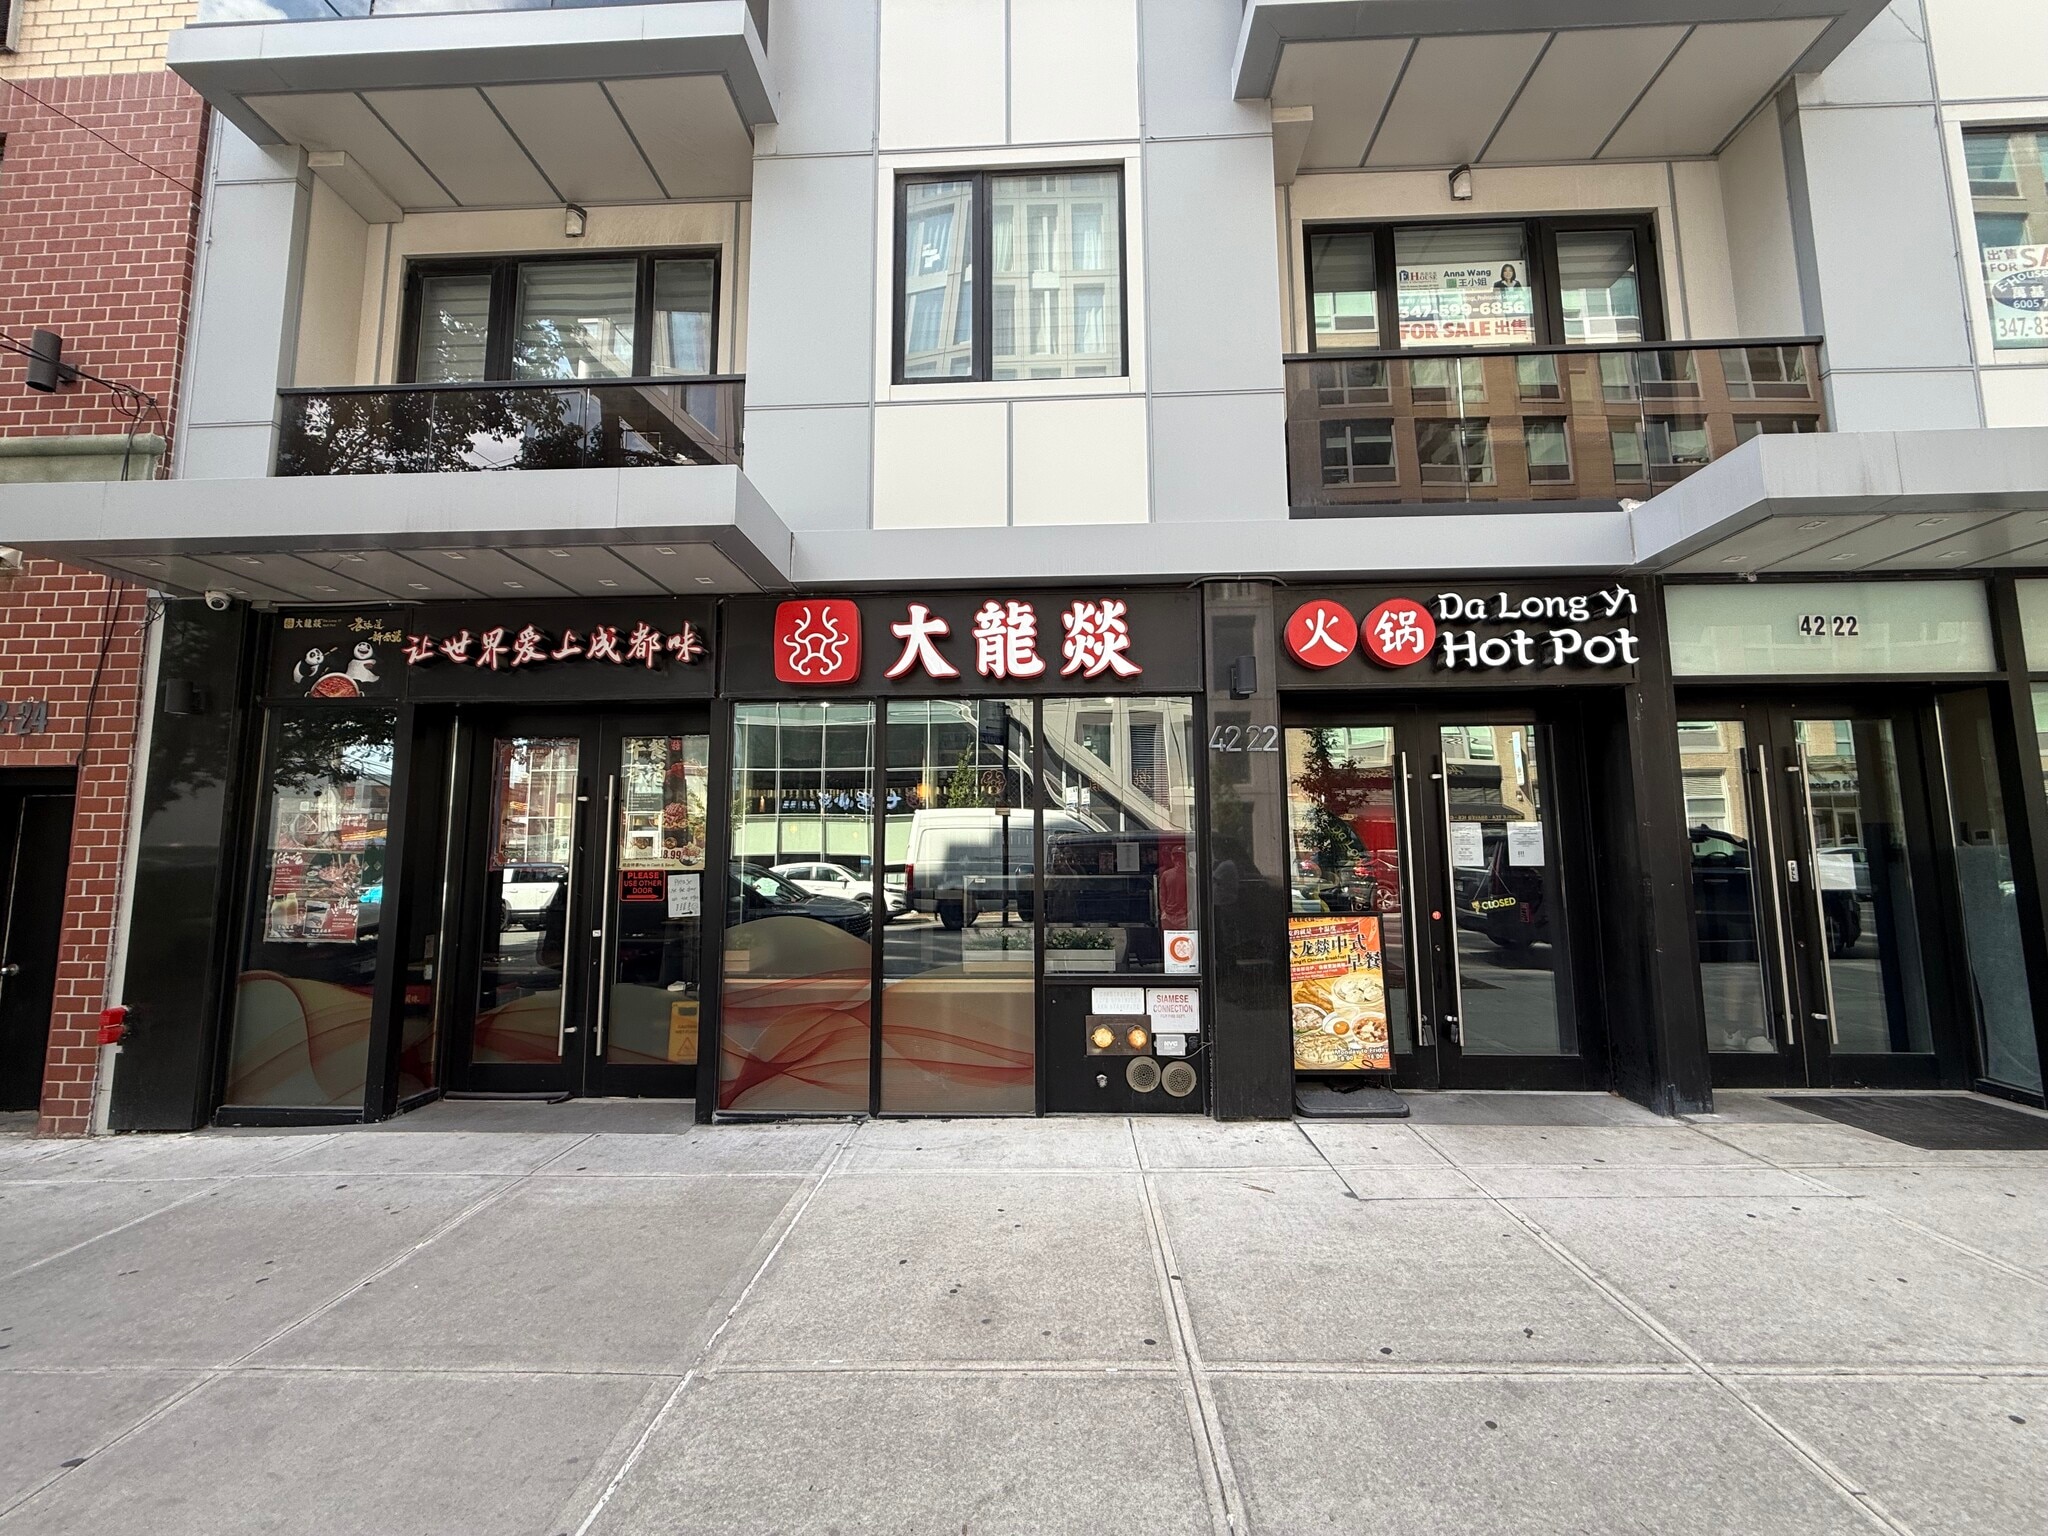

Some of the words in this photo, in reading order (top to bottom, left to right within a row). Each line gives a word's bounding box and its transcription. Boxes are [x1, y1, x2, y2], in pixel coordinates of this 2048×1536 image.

[1443, 270, 1466, 278] Anna
[1467, 269, 1492, 278] Wang
[1990, 263, 2019, 273] FOR
[1458, 277, 1488, 287] 王小姐
[1400, 322, 1439, 339] FOR
[1443, 320, 1490, 338] SALE
[1438, 592, 1487, 621] Da
[1498, 591, 1590, 622] Long
[1600, 583, 1639, 617] Yi
[1298, 608, 1426, 655] 火锅
[884, 598, 1144, 680] 大龍燚
[404, 619, 703, 672] 让世界爱上成都味
[1443, 629, 1535, 668] Hot
[1549, 626, 1640, 667] Pot
[627, 871, 660, 879] PLEASE
[638, 879, 662, 887] OTHER
[1481, 896, 1517, 910] CLOSED
[1156, 994, 1189, 1003] SIAMESE
[1153, 1004, 1193, 1013] CONNECTION
